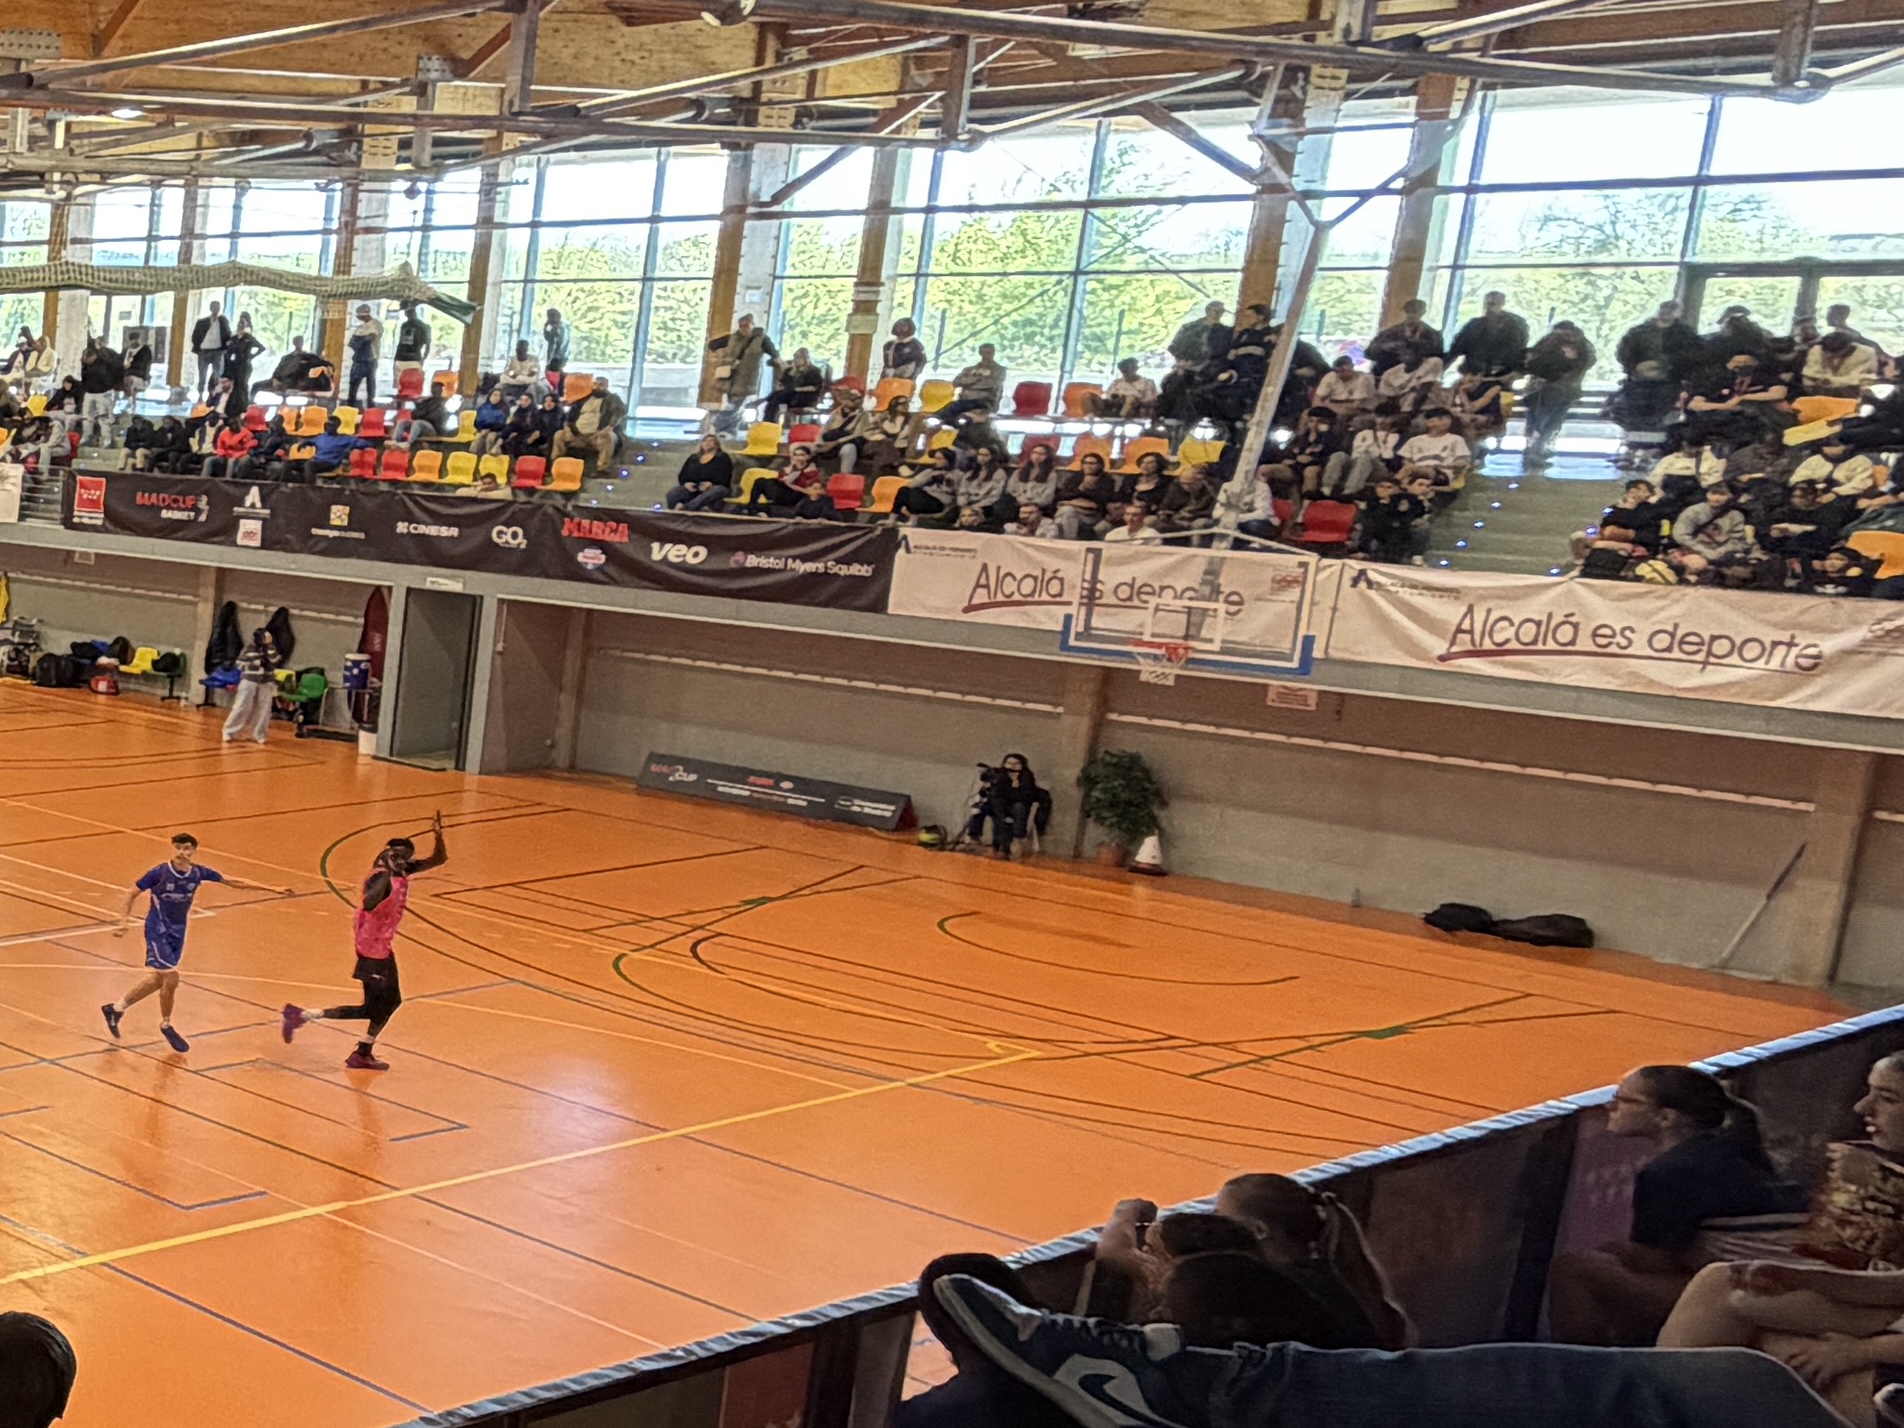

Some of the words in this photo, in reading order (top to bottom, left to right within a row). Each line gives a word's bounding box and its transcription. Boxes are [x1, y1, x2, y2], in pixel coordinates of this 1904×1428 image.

[135, 491, 198, 509] MADCUP
[561, 517, 630, 543] MARCA
[650, 541, 709, 565] veo
[745, 554, 786, 570] Bristol
[787, 557, 826, 575] Myers
[826, 560, 873, 577] Squibb
[968, 562, 1065, 605] Alcalá
[1446, 604, 1581, 656] Alcalá
[1592, 623, 1635, 652] es
[1647, 622, 1825, 672] deporte
